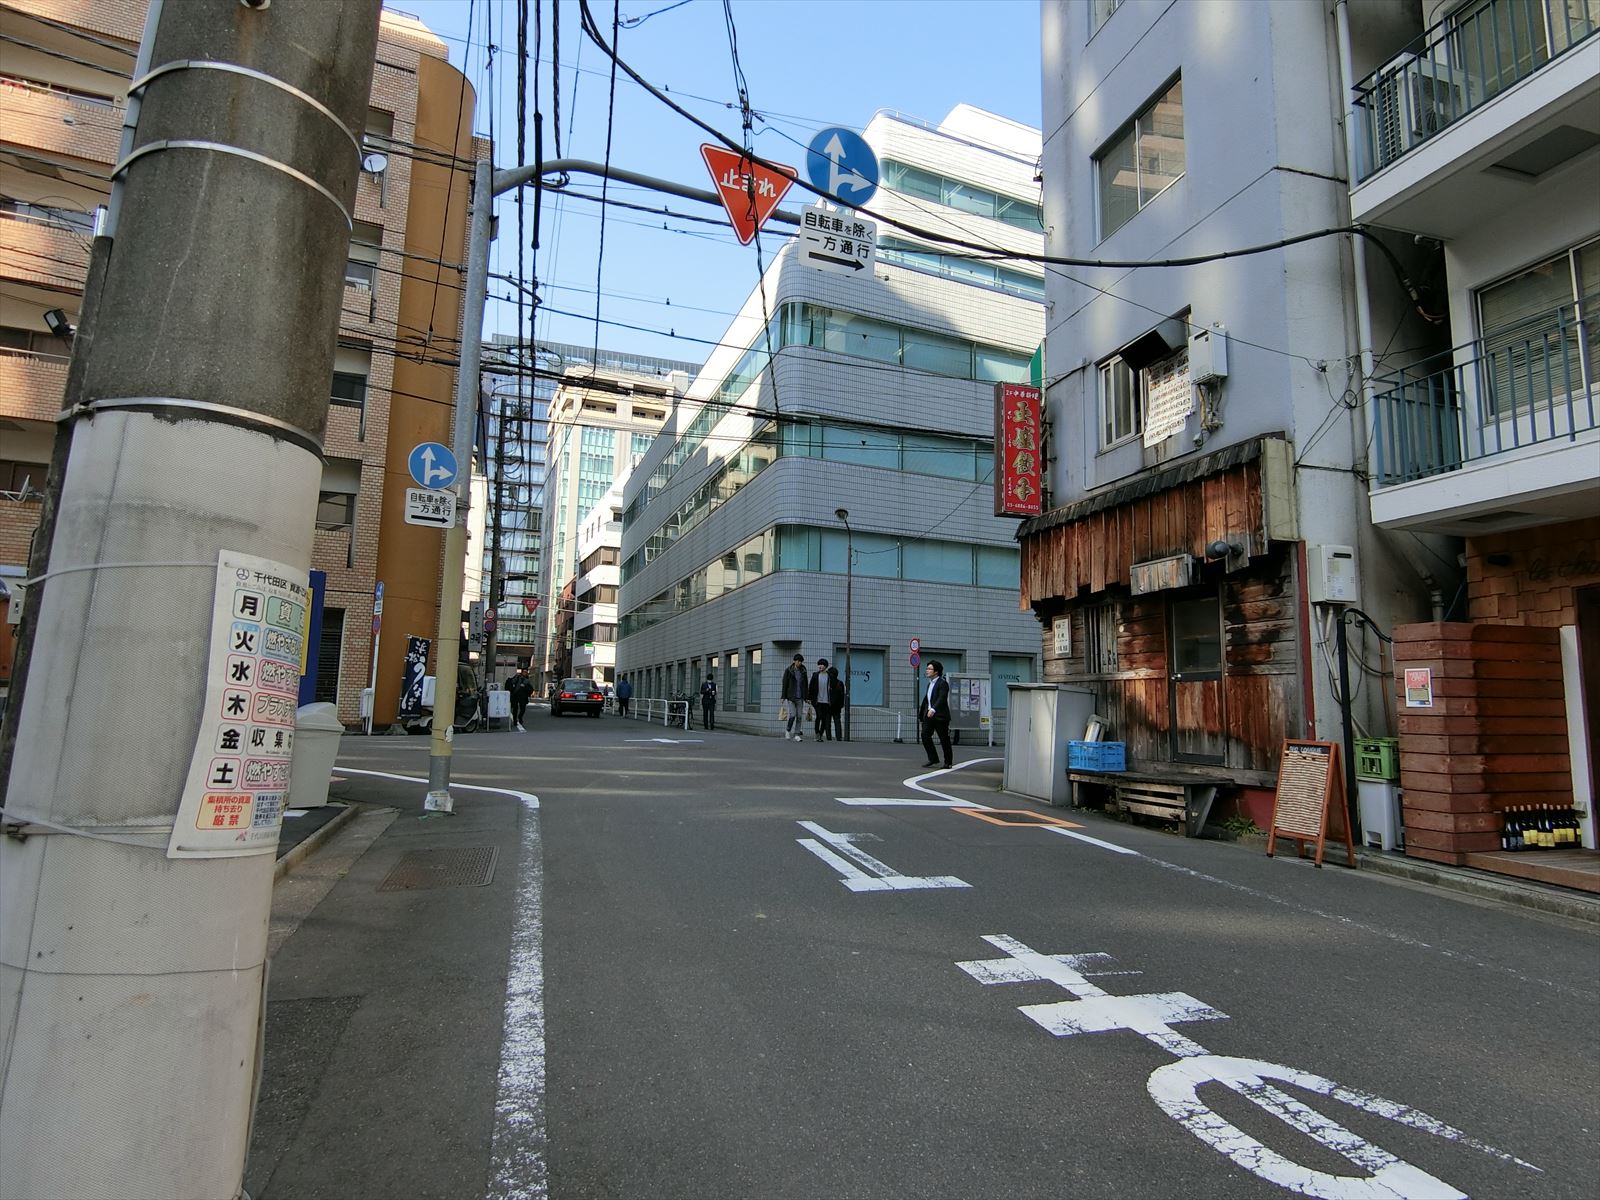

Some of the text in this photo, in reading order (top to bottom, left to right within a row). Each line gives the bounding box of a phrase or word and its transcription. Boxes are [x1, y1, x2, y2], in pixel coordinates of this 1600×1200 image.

[720, 168, 777, 198] 止まれ
[804, 211, 873, 241] 自転車を除く
[806, 235, 870, 260] 一方通行
[410, 492, 452, 505] 自転車を除く
[409, 504, 452, 517] 一方通行
[254, 571, 288, 590] 千代田区
[240, 594, 259, 617] 月
[234, 631, 255, 652] 火
[231, 661, 251, 682] 水
[227, 694, 246, 715] 木
[219, 728, 241, 750] 金
[212, 762, 234, 784] 土
[214, 805, 243, 814] 持ち去り
